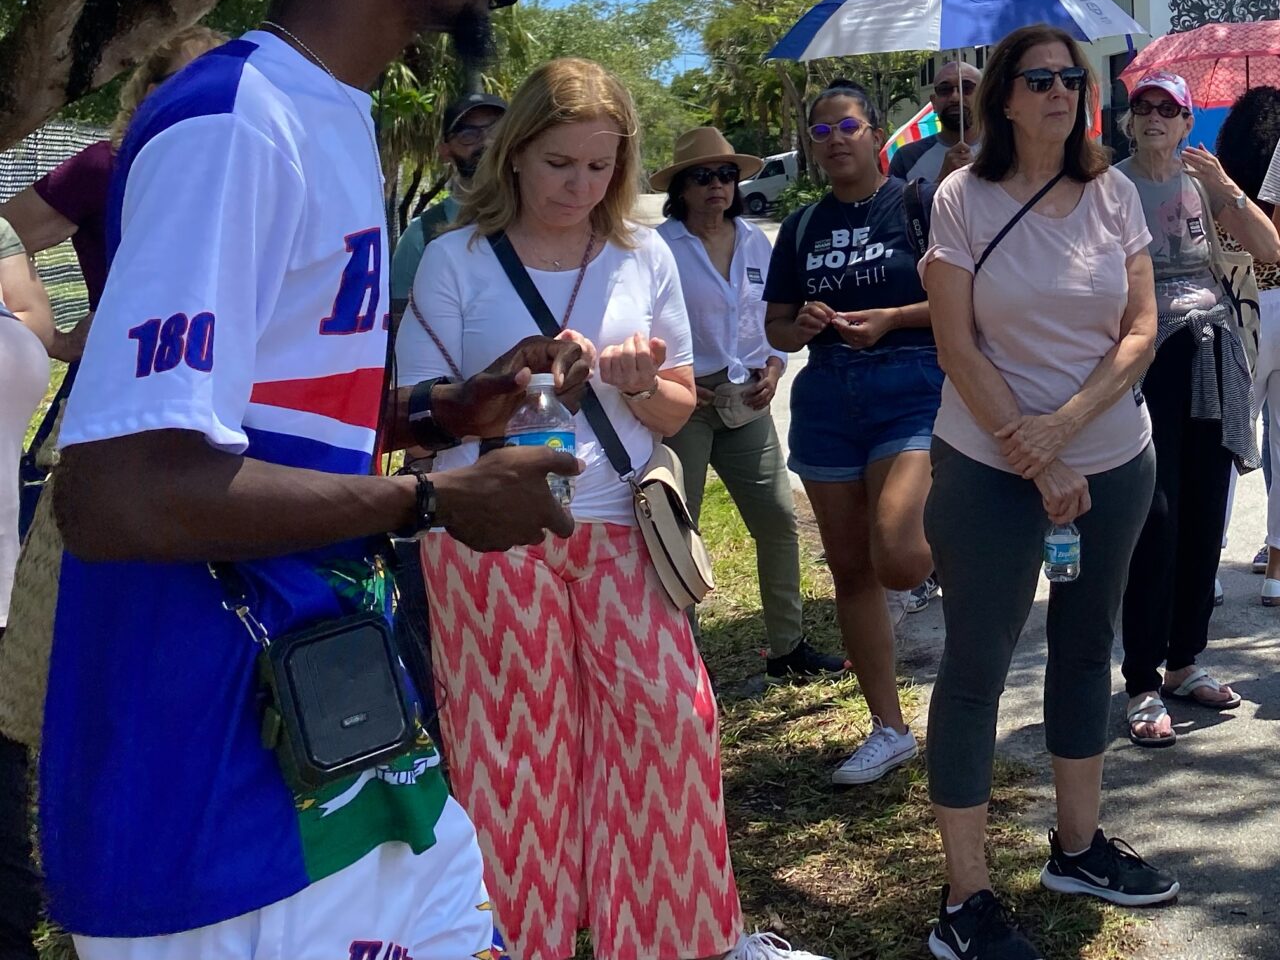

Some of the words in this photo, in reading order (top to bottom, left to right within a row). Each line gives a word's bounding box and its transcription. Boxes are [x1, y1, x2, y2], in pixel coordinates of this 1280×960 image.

[831, 226, 871, 248] BE
[806, 242, 894, 271] BOLD.
[806, 273, 846, 294] SAY
[855, 265, 887, 287] HI!
[128, 311, 216, 378] 180
